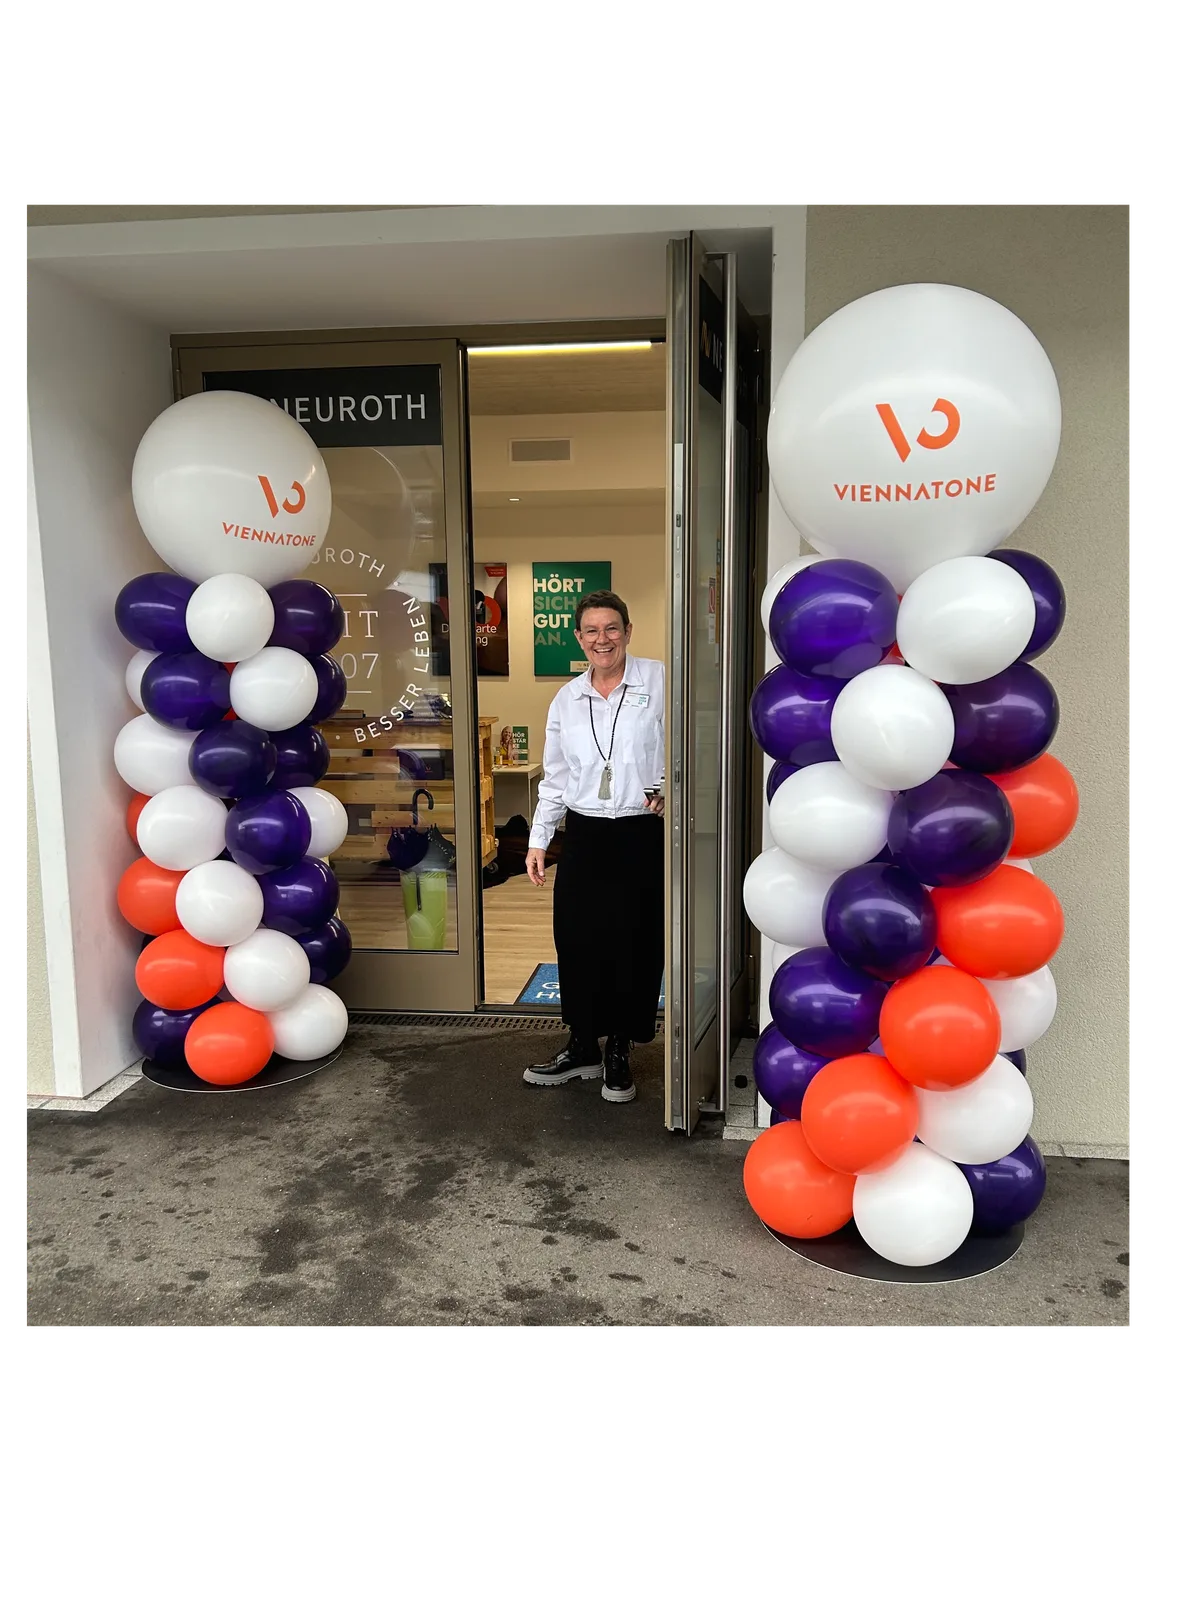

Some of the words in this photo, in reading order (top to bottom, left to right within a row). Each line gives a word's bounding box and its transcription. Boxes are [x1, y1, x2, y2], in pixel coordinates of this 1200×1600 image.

[833, 473, 997, 502] VIENNATONE
[222, 521, 316, 547] VIENNATONE
[311, 547, 385, 578] UROTH
[533, 573, 586, 593] HÖRT
[534, 595, 577, 611] SICH
[342, 610, 379, 638] IT
[475, 623, 497, 634] arte
[534, 613, 572, 629] GUT
[534, 631, 567, 646] AN.
[340, 652, 379, 679] 07
[354, 683, 423, 743] BESSER
[402, 597, 430, 673] LEBEN
